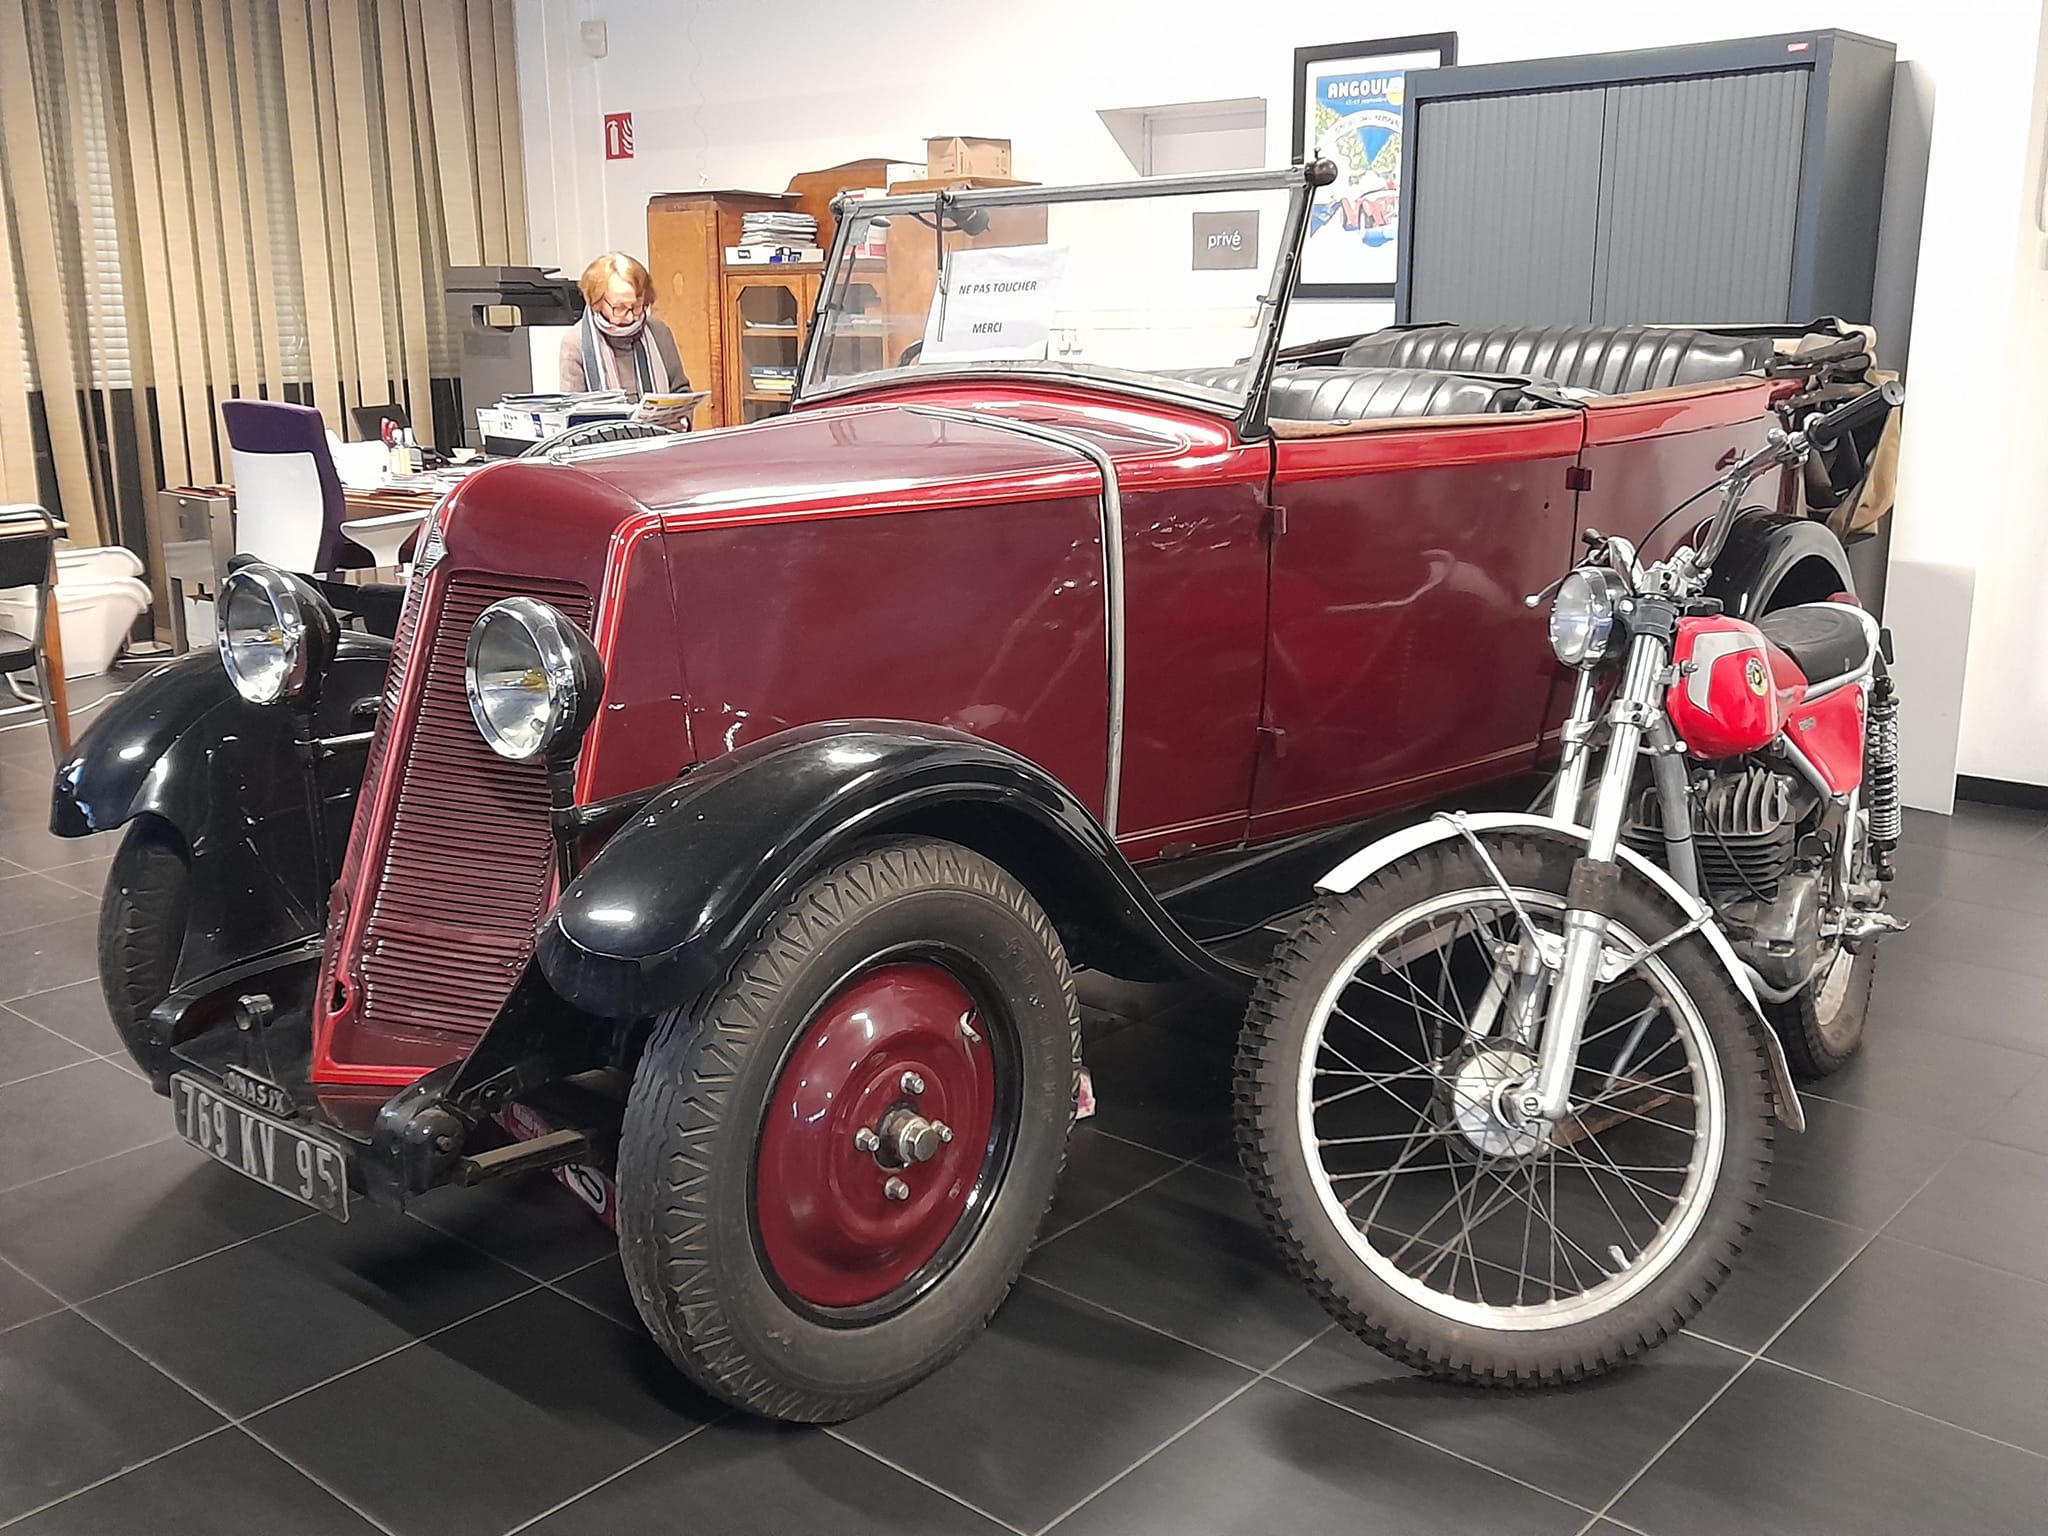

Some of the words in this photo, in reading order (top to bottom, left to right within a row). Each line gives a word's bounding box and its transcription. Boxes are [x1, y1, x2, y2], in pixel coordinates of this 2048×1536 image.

[1207, 229, 1241, 250] privé
[958, 284, 972, 296] NE
[973, 283, 991, 294] PAS
[993, 280, 1037, 293] TOUCHER
[972, 322, 1003, 334] MERCI
[181, 1083, 227, 1158] 769
[240, 1113, 275, 1184] KV
[296, 1140, 338, 1209] 95
